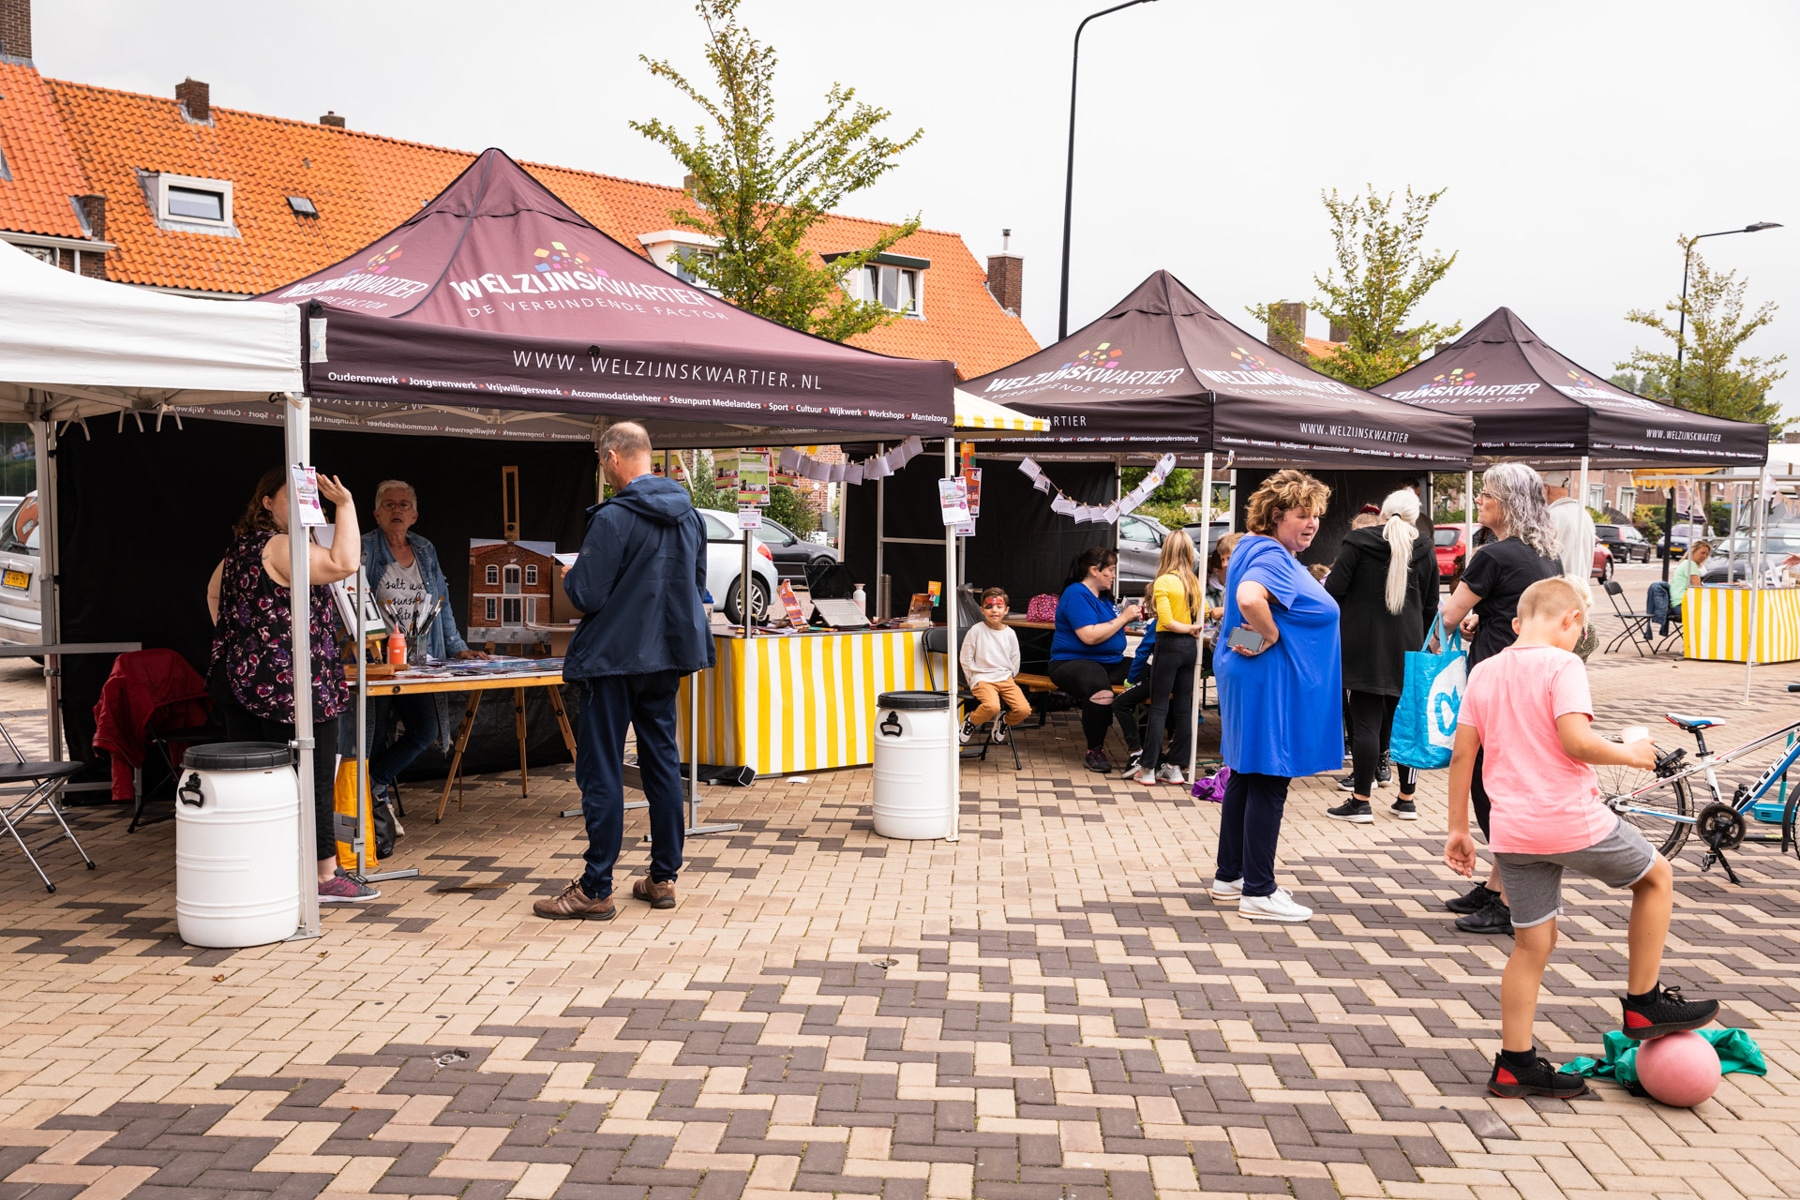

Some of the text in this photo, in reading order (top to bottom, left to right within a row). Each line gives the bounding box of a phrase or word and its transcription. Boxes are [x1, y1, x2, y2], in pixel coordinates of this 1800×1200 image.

[449, 270, 714, 308] WELZIJNSKWARTIER
[466, 297, 730, 320] DE VERBINDENDE FACTOR
[512, 350, 822, 390] WWW.WELZIJNSKWARTIER.NL
[984, 365, 1185, 393] WELZIJNSKWARTIER
[328, 372, 948, 424] Ouderenwerk Jongerenwerk Vrijwilligerswerk Accommodatiebeheer Steunpunt Medelanders Sport Cultuur Wijkwerk Workshops Mantelzorg
[991, 382, 1094, 400] VERBINDENDE
[1098, 387, 1164, 396] FACTOR
[1391, 383, 1541, 400] ZIJNSKWARTIER
[1465, 396, 1526, 404] FACTOR
[1129, 435, 1199, 443] Mantelzorgondersteuning
[1299, 422, 1409, 444] WWW.WELZIJNSKWARTIER
[385, 578, 406, 590] salt
